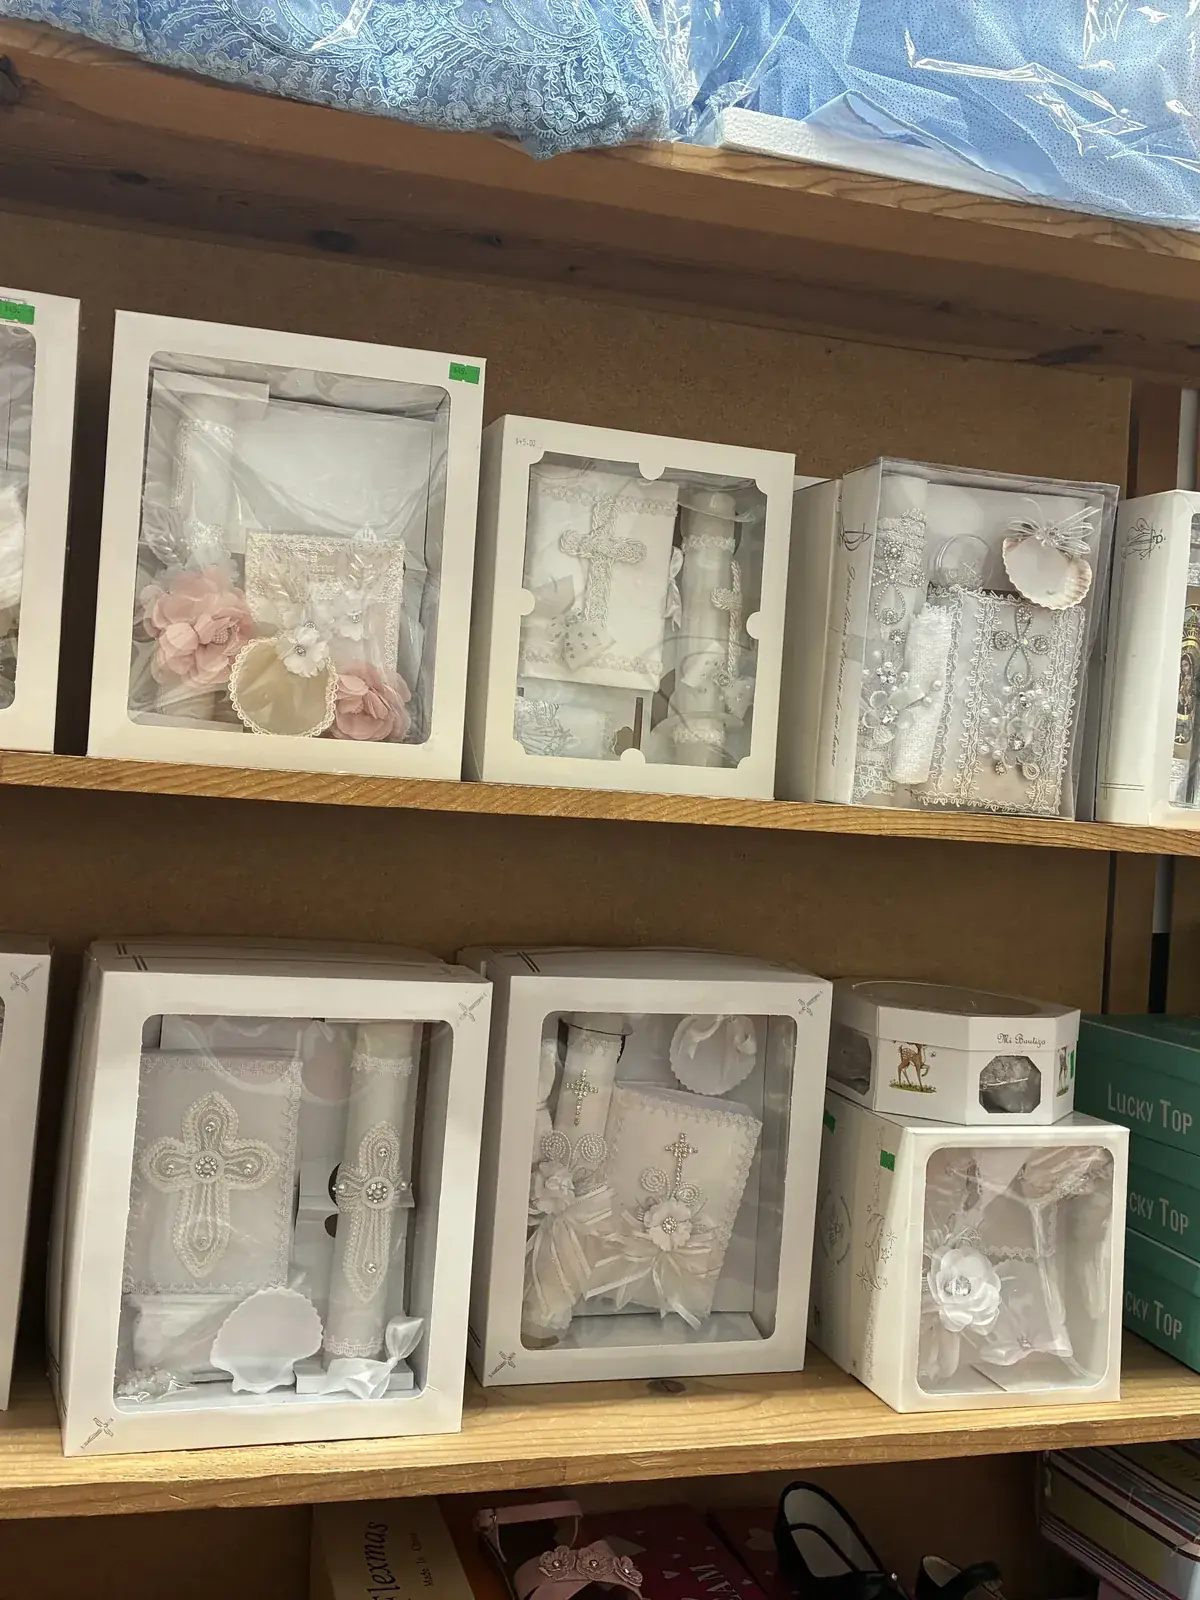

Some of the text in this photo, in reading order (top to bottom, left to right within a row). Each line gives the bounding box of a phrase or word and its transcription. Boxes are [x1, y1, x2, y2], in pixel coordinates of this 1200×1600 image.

[997, 1033, 1046, 1048] Mi Bautizo
[1128, 1192, 1155, 1220] CKY
[1124, 1290, 1150, 1321] CKY
[364, 1521, 401, 1600] lexmas
